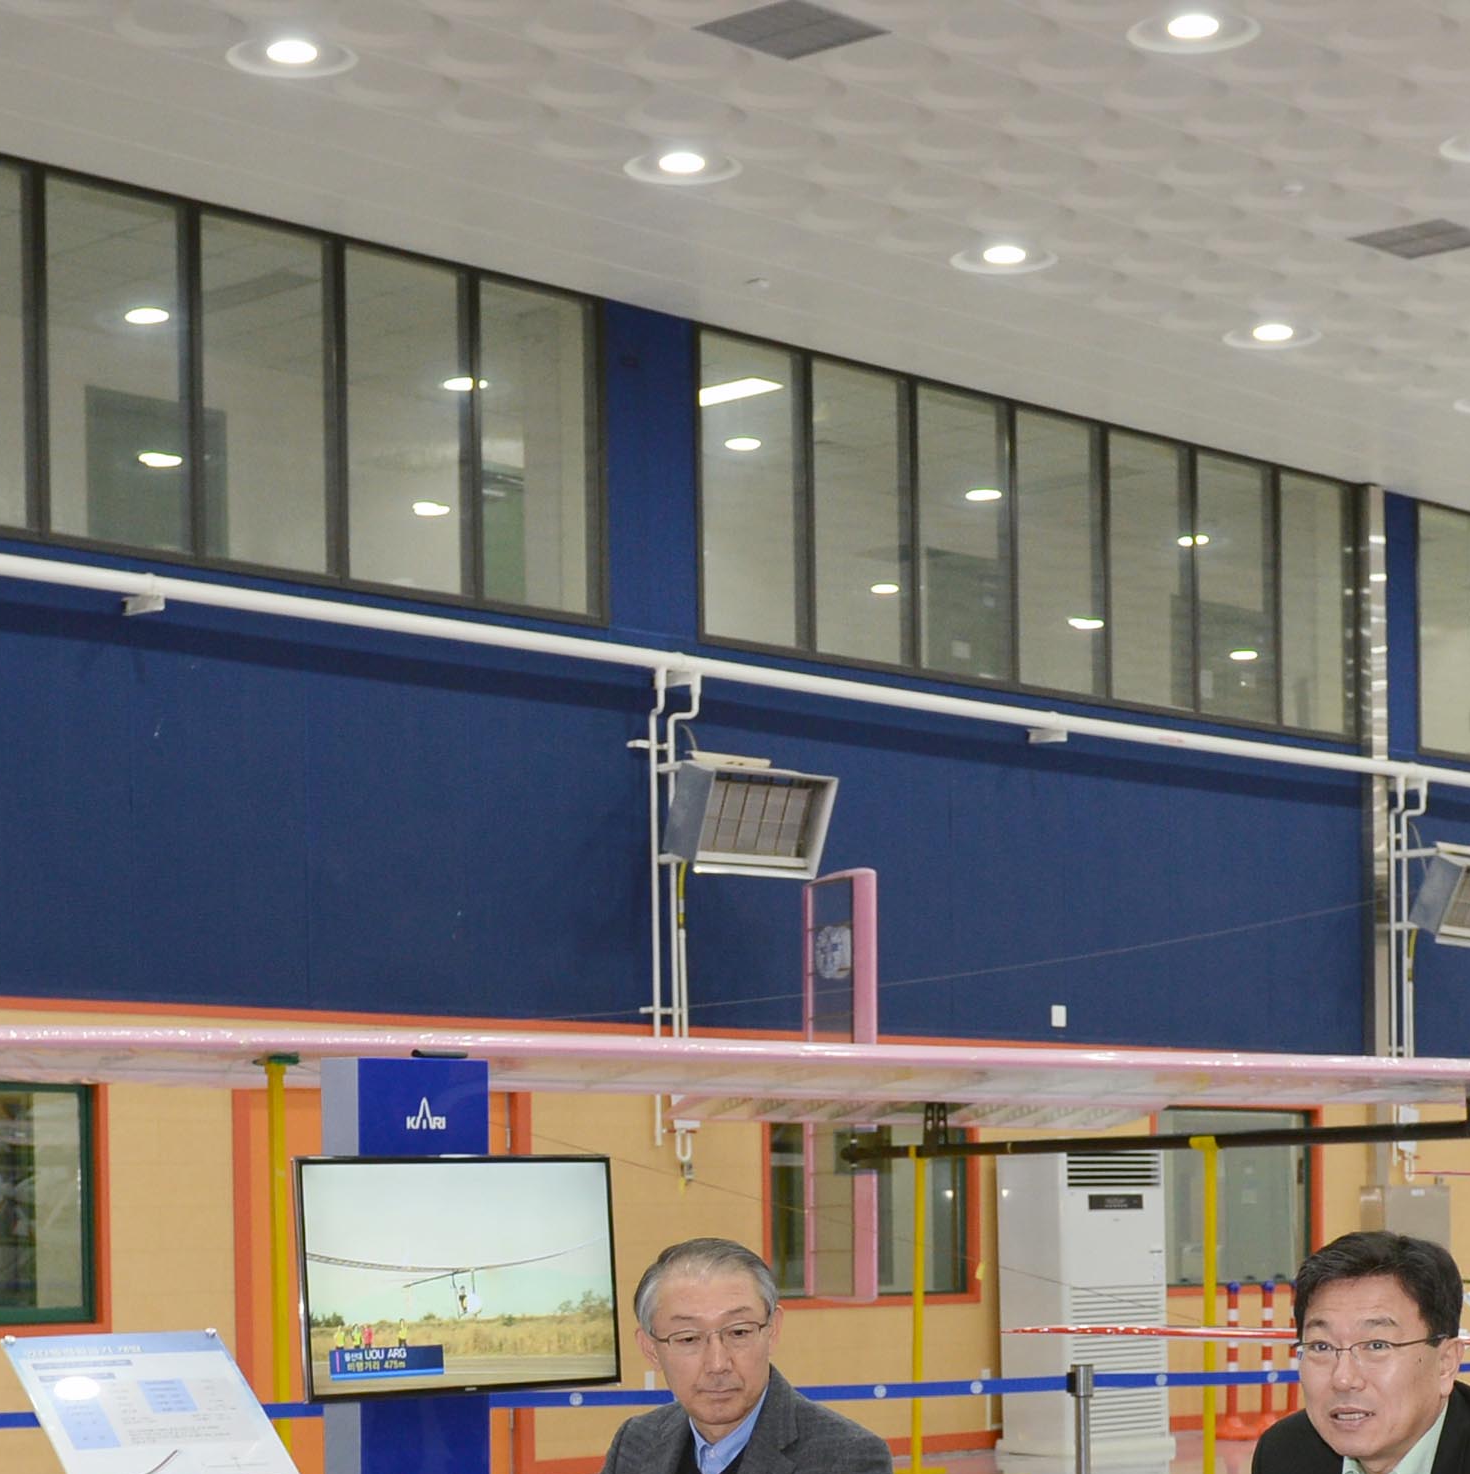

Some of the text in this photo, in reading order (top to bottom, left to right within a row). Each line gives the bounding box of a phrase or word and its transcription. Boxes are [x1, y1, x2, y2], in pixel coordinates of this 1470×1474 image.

[406, 1096, 446, 1130] KARI
[364, 1349, 385, 1361] UOU
[387, 1347, 407, 1359] ARG
[384, 1360, 406, 1369] 475m
